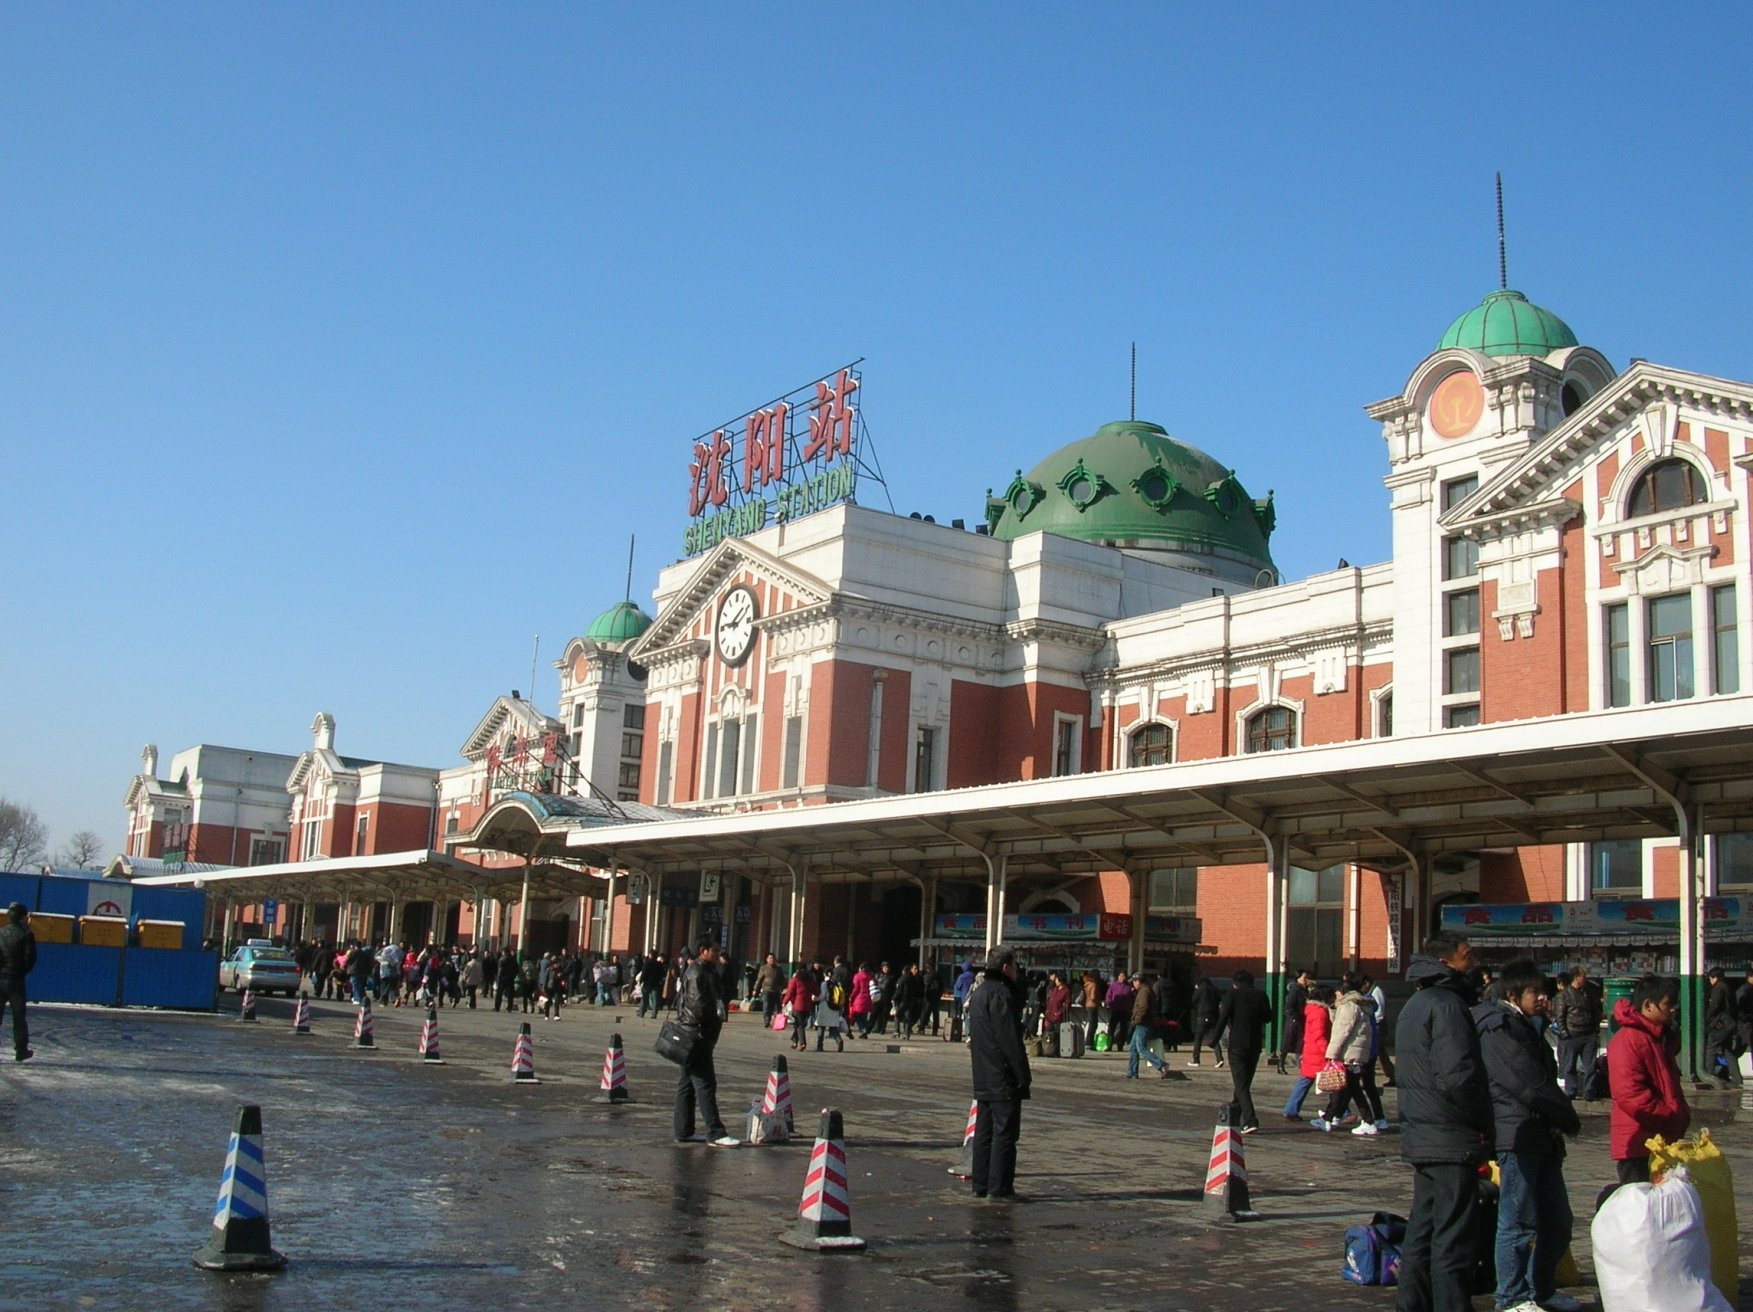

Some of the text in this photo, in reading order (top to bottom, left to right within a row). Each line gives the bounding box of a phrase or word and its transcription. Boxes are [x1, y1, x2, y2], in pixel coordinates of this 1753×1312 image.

[689, 369, 858, 517] 沈阳站
[684, 461, 853, 557] SHENYANG STATION
[1103, 919, 1129, 935] 电话
[1462, 906, 1554, 924] 食品
